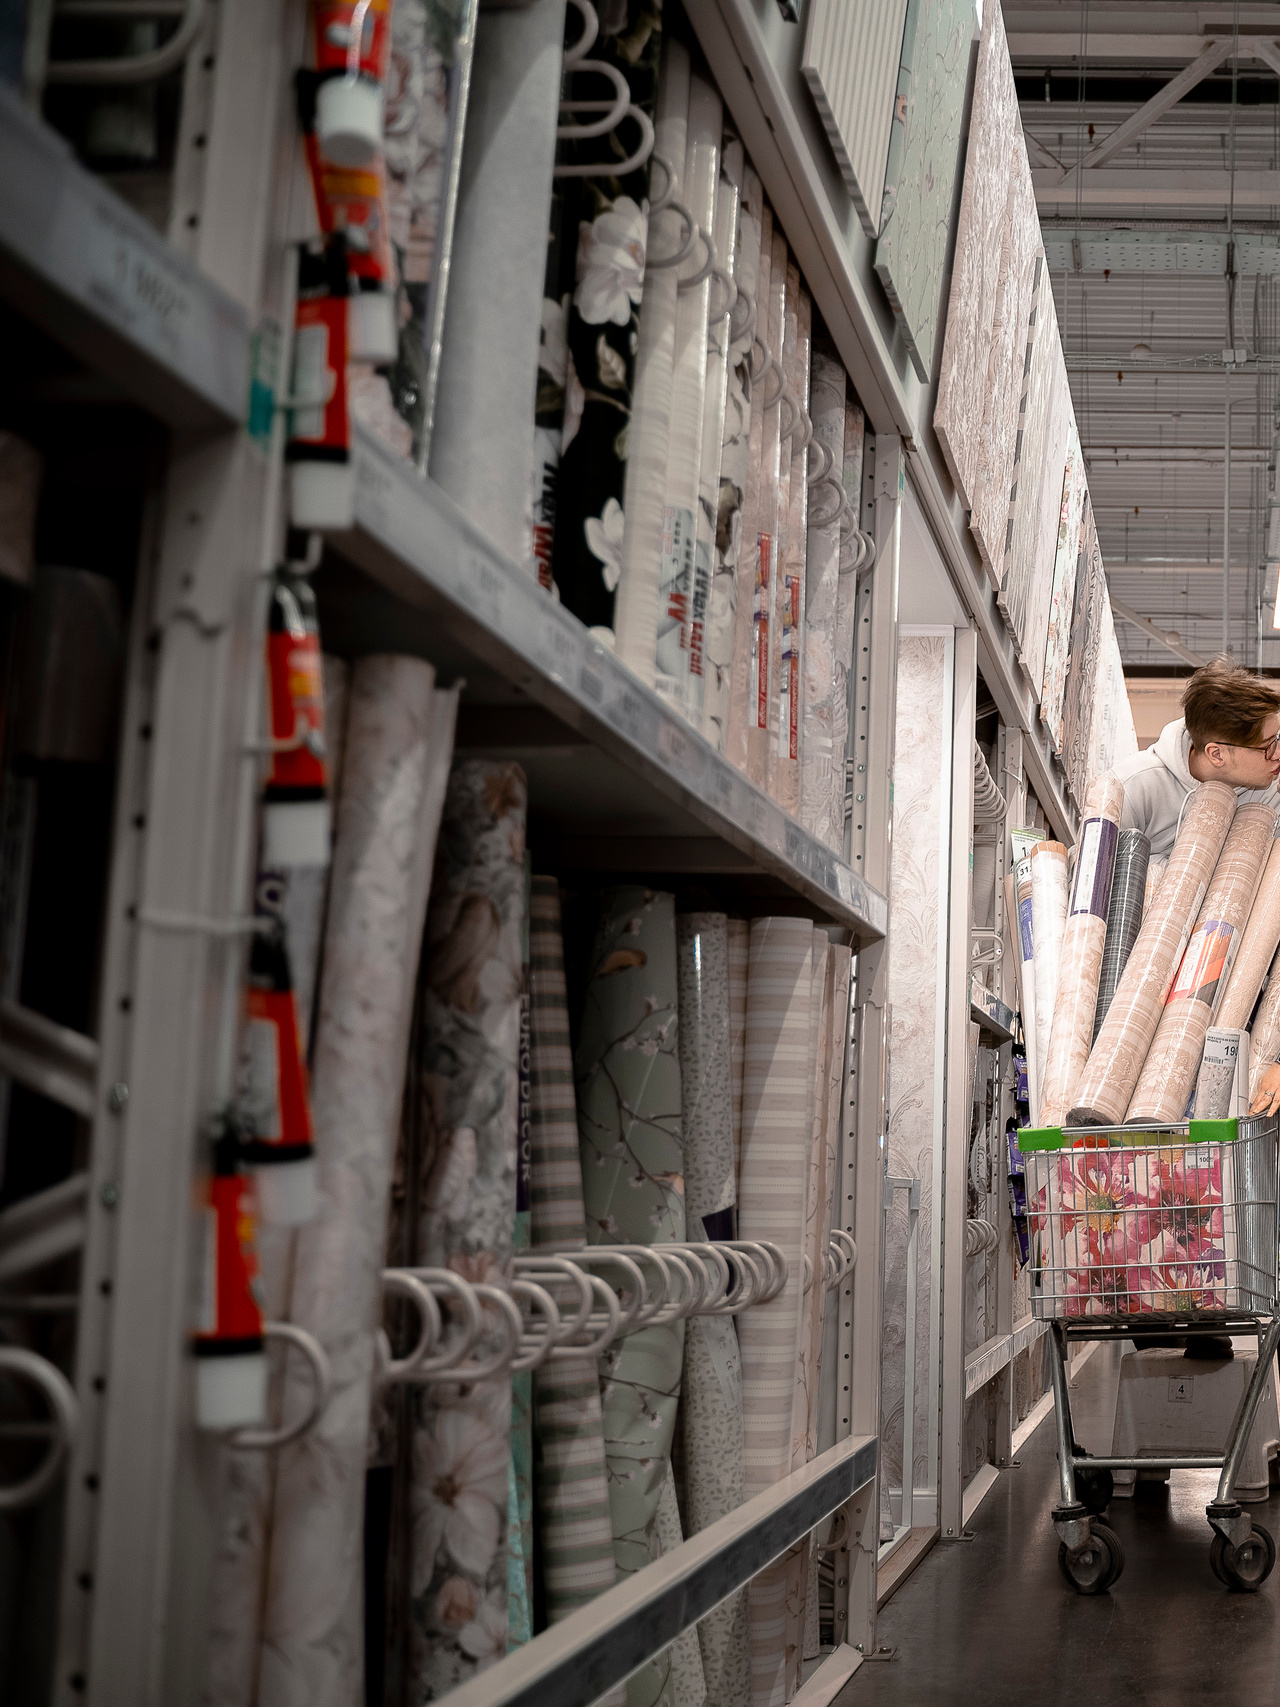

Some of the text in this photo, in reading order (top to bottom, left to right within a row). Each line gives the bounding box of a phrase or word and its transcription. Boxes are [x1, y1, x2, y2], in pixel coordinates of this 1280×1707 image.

[519, 993, 531, 1181] EURO DECOR
[1178, 1384, 1185, 1394] 4
